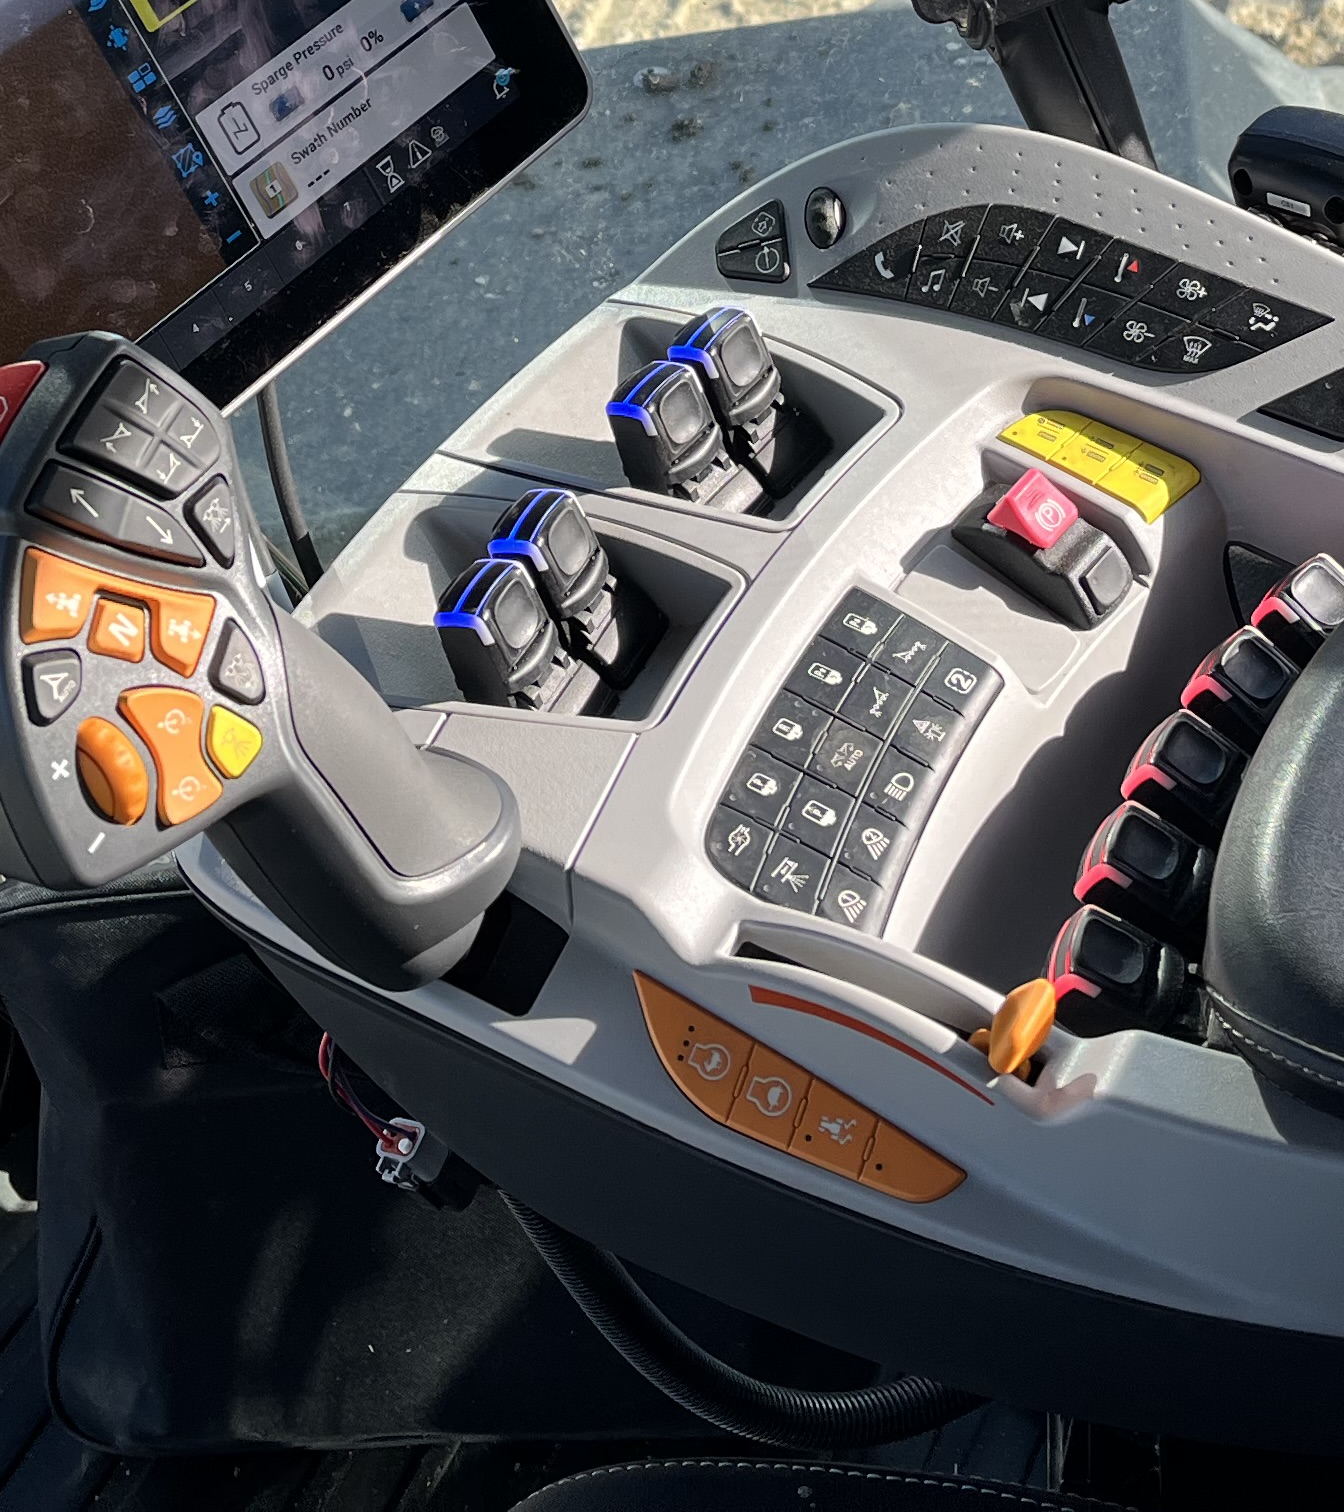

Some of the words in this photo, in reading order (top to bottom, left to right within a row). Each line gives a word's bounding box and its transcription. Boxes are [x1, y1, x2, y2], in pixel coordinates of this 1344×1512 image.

[359, 29, 384, 51] 0%
[251, 61, 293, 95] Sparge
[292, 24, 343, 65] Pressure
[290, 132, 327, 164] Swath
[326, 97, 371, 137] Number
[108, 612, 139, 647] N
[951, 672, 971, 690] 2
[844, 750, 863, 771] AUTO
